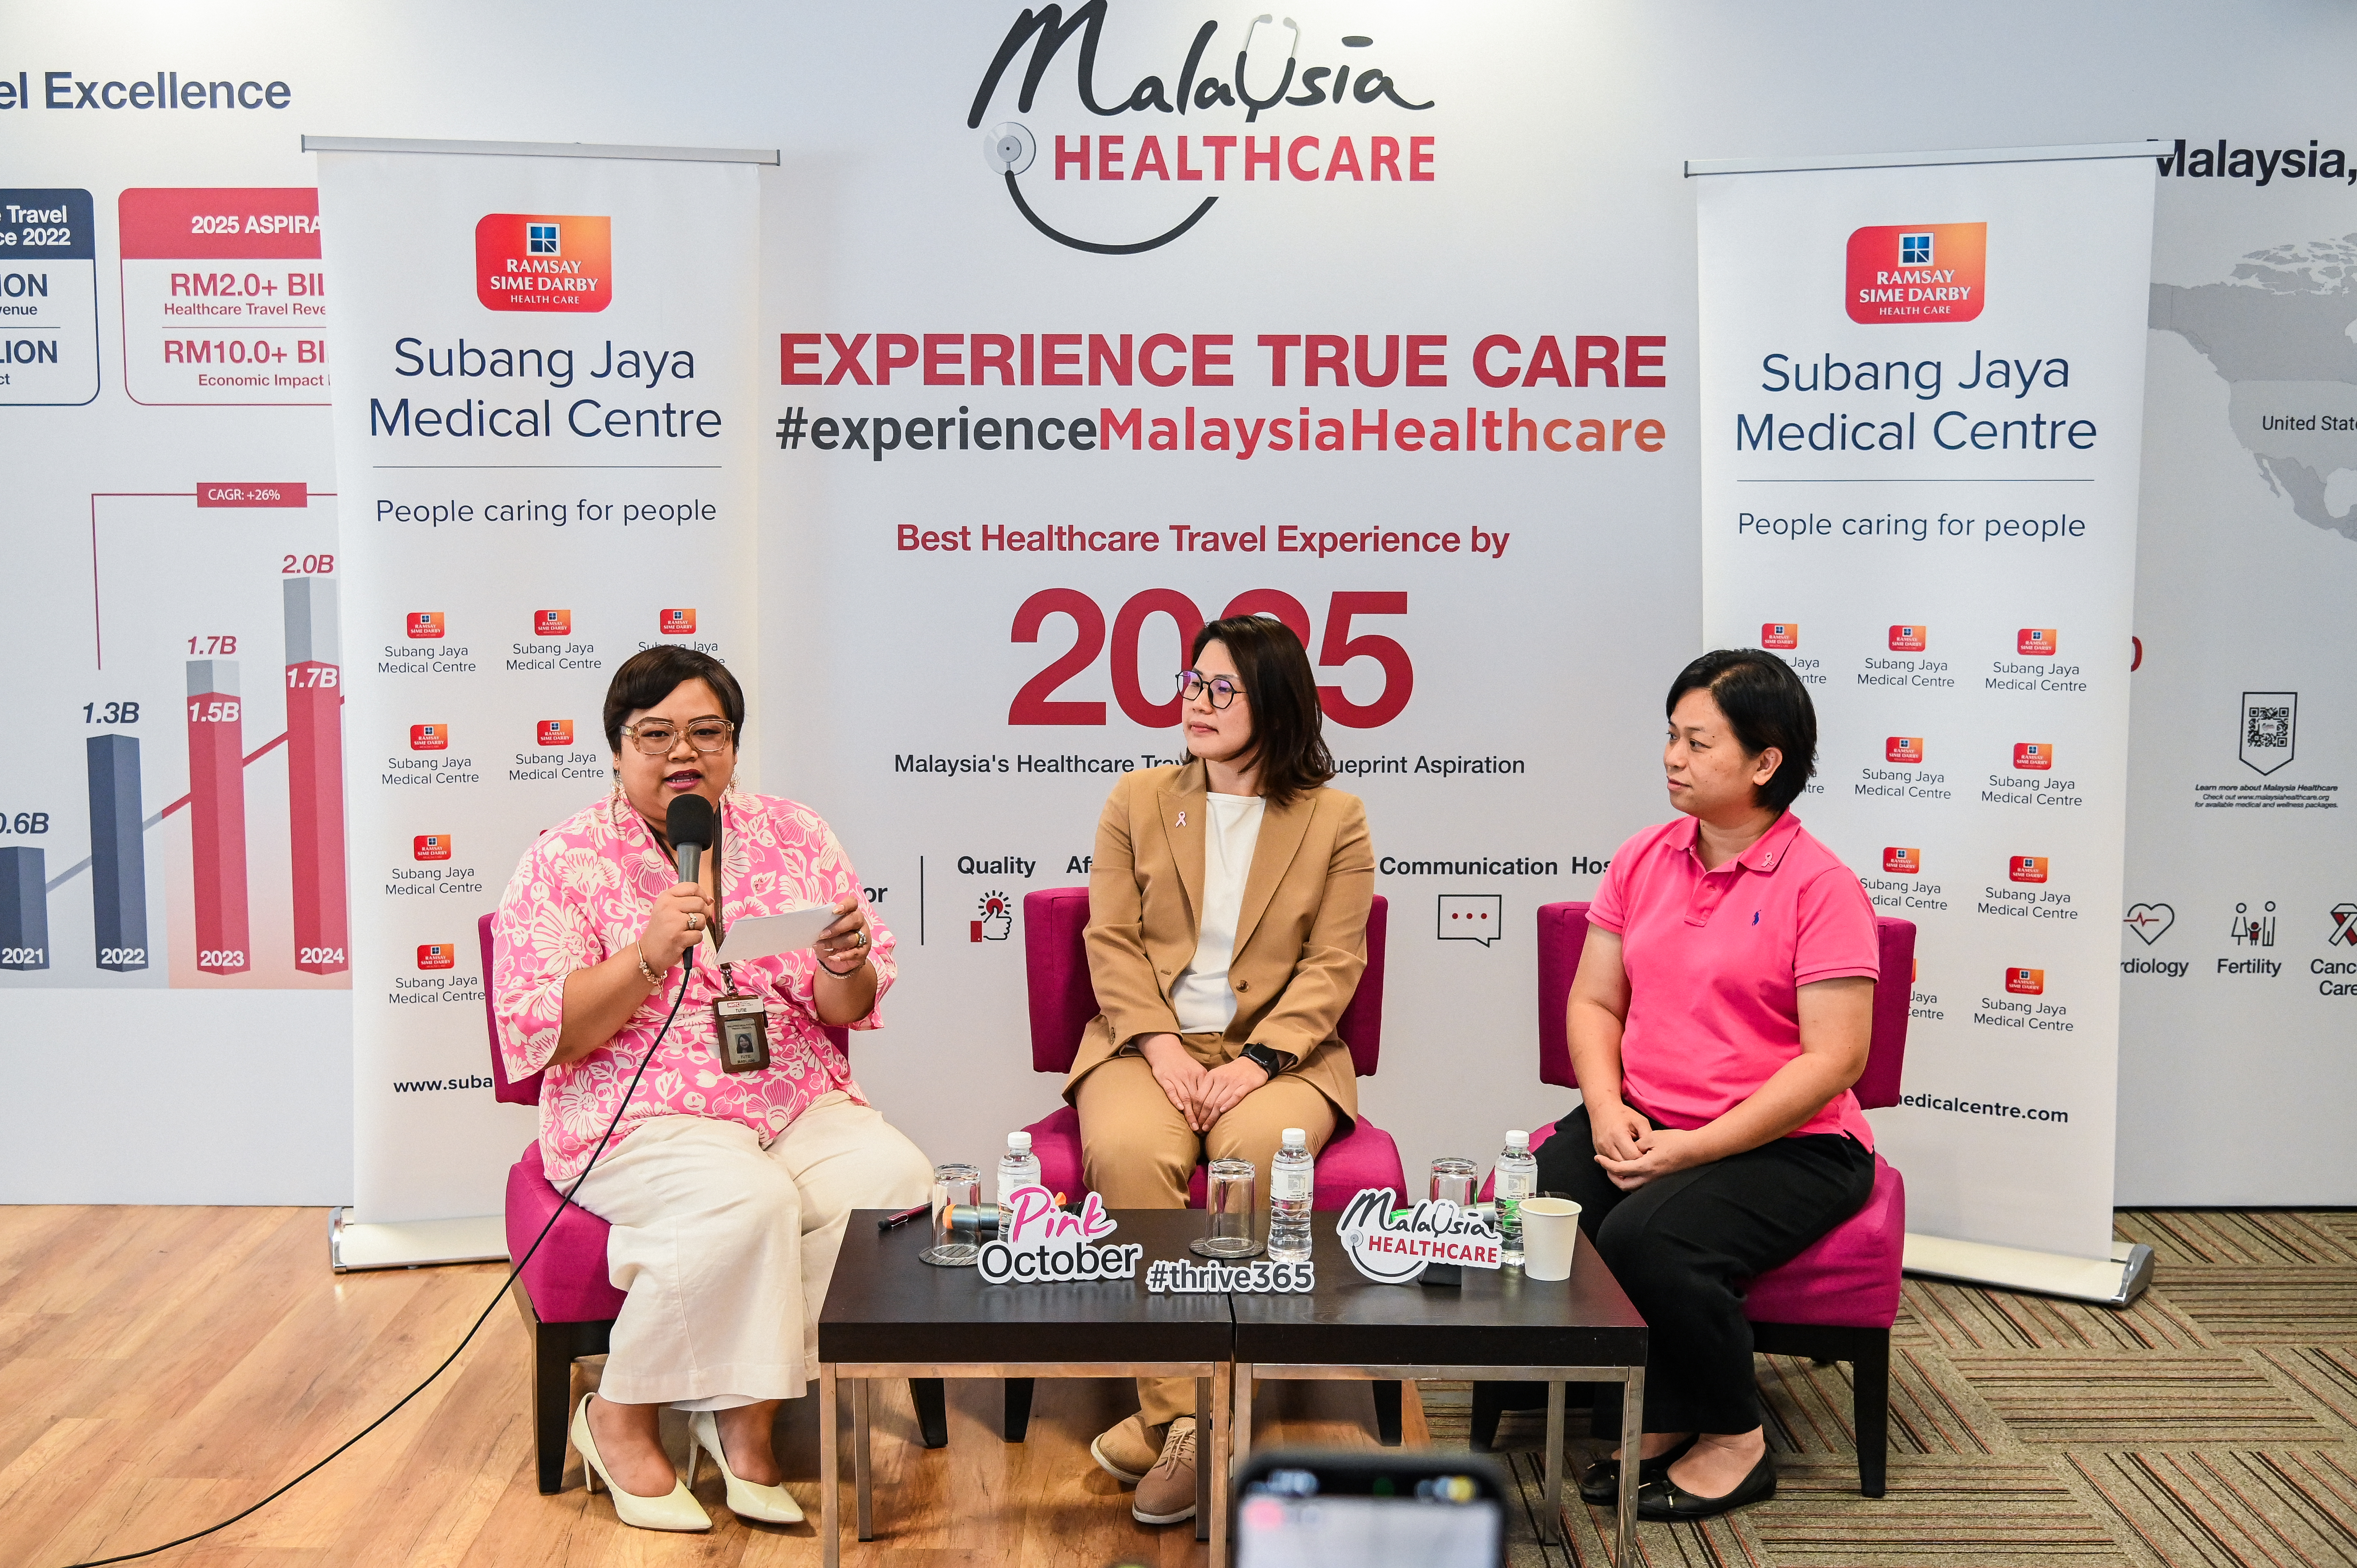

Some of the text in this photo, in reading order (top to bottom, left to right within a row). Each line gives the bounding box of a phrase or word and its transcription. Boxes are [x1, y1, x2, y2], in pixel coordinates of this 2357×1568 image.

[968, 0, 1434, 129] Malaysia
[45, 72, 291, 109] Excellence
[1055, 135, 1434, 181] HEALTHCARE
[6, 205, 67, 223] Travel
[191, 216, 239, 234] 2025
[23, 228, 71, 245] 2022
[506, 259, 582, 275] RAMSAY
[172, 274, 277, 296] RM2.0+
[491, 276, 598, 292] SIME DARBY
[1877, 270, 1955, 284] RAMSAY
[1860, 287, 1970, 303] SIME DARBY
[165, 303, 241, 315] Healthcare
[246, 303, 287, 314] Travel
[165, 341, 287, 363] RM10.0+
[781, 333, 1666, 388] EXPERIENCE TRUE CARE
[396, 338, 693, 388] Subang Jaya
[199, 374, 324, 388] Economic Impact
[1762, 350, 2068, 400] Subang Jaya
[371, 399, 721, 437] Medical Centre
[2263, 415, 2357, 430] United Stat
[776, 406, 1665, 461] #experienceMalaysiaHealthcare
[1738, 411, 2096, 451] Medical Centre
[209, 489, 280, 500] CAGR: +26%
[378, 499, 716, 527] People caring for people
[1740, 513, 2085, 542] People caring for people
[898, 524, 1510, 558] Best Healthcare Travel Experience by
[282, 554, 334, 574] 2.0B
[188, 636, 236, 654] 1.7B
[385, 645, 468, 659] Subang Jaya
[513, 642, 594, 656] Subang Jaya
[379, 662, 475, 673] Medical Centre
[507, 658, 601, 670] Medical Centre
[1791, 657, 1819, 670] Jaya
[1865, 658, 1947, 673] Subang Jaya
[1994, 662, 2079, 677] Subang Jaya
[288, 668, 337, 688] 1.7B
[1858, 674, 1954, 687] Medical Centre
[1986, 678, 2086, 691] Medical Centre
[84, 702, 139, 723] 1.3B
[189, 702, 239, 723] 1.5B
[389, 757, 471, 770] Subang Jaya
[516, 752, 596, 765] Subang Jaya
[895, 755, 1009, 777] Malaysia's
[1018, 755, 1134, 772] Healthcare
[1332, 756, 1406, 777] ueprint
[1414, 756, 1524, 778] Aspiration
[383, 773, 479, 784] Medical Centre
[510, 768, 603, 780] Medical Centre
[1863, 769, 1944, 784] Subang Jaya
[1855, 784, 1951, 799] Medical Centre
[1990, 775, 2074, 791] Subang Jaya
[1982, 791, 2082, 805] Medical Centre
[393, 867, 474, 880] Subang Jaya
[958, 856, 1036, 878] Quality
[1380, 857, 1557, 875] Communication
[386, 883, 482, 894] Medical Centre
[1860, 878, 1940, 895] Subang Jaya
[1906, 897, 1947, 910] Centre
[1986, 887, 2070, 905] Subang Jaya
[1978, 903, 2077, 919] Medical Centre
[2, 947, 43, 965] 2021
[101, 948, 145, 966] 2022
[200, 951, 245, 968] 2023
[300, 948, 345, 964] 2024
[2218, 959, 2281, 977] Fertility
[396, 976, 477, 989] Subang Jaya
[2320, 980, 2357, 995] Care
[390, 990, 485, 1003] Medical Centre
[1910, 991, 1937, 1004] Jaya
[1908, 1006, 1944, 1020] entre
[1982, 998, 2066, 1016] Subang Jaya
[1974, 1013, 2073, 1031] Medical Centre
[1007, 1188, 1111, 1243] Pink
[1341, 1192, 1497, 1239] Malaysia
[1369, 1236, 1497, 1263] HEALTHCARE
[983, 1242, 1138, 1277] October
[1150, 1262, 1311, 1292] #thrive365
